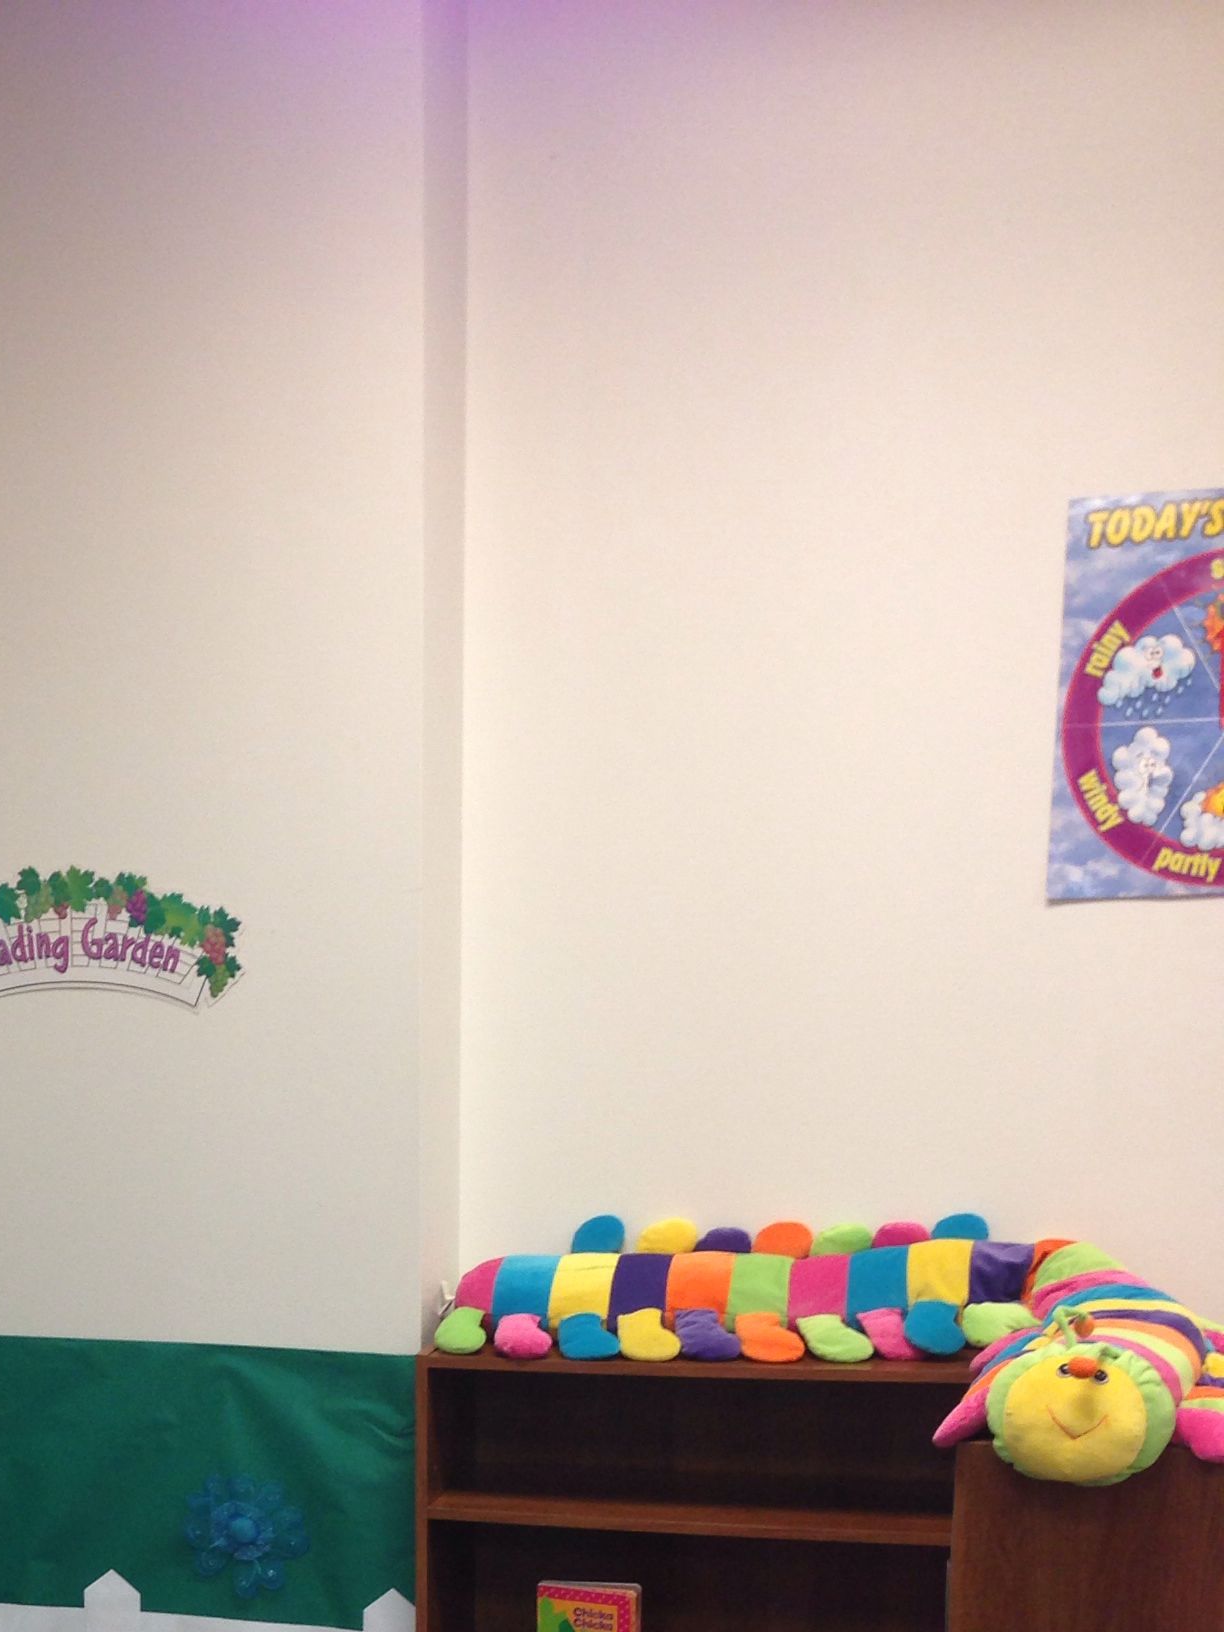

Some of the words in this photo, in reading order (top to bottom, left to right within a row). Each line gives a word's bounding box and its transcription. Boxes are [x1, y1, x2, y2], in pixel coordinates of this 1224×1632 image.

[1085, 498, 1224, 549] TODAY'S
[1085, 620, 1130, 679] rainy
[1078, 769, 1124, 832] windy
[1152, 846, 1222, 883] partly
[81, 917, 180, 973] Garden
